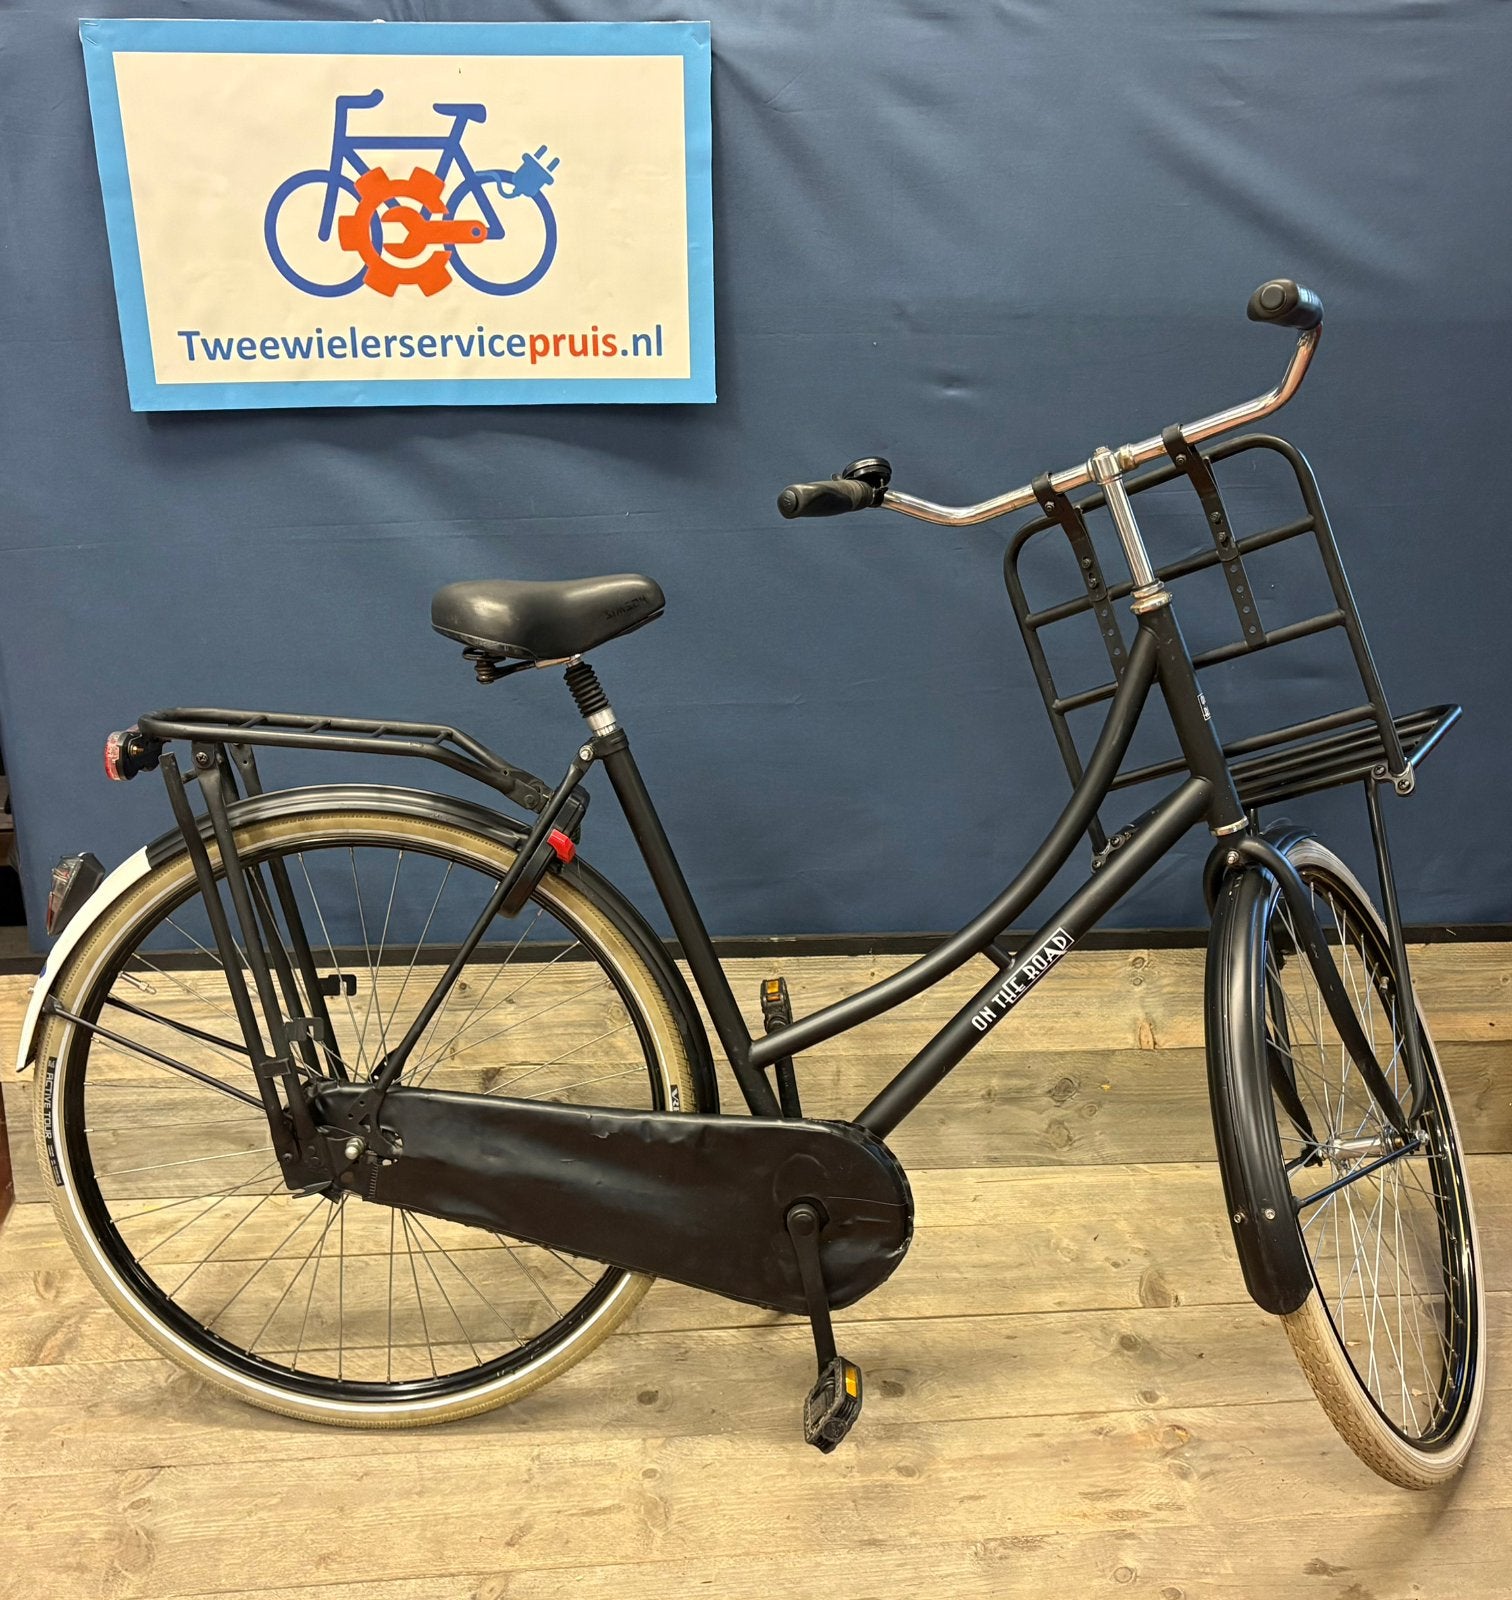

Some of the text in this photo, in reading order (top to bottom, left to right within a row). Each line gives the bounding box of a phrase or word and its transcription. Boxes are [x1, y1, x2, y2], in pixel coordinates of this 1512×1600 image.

[177, 324, 662, 364] Tweewielerservicepruis.nl
[971, 936, 1068, 1031] ON THE ROAD
[44, 1072, 54, 1109] ACTIVE
[44, 1111, 53, 1139] TOUR
